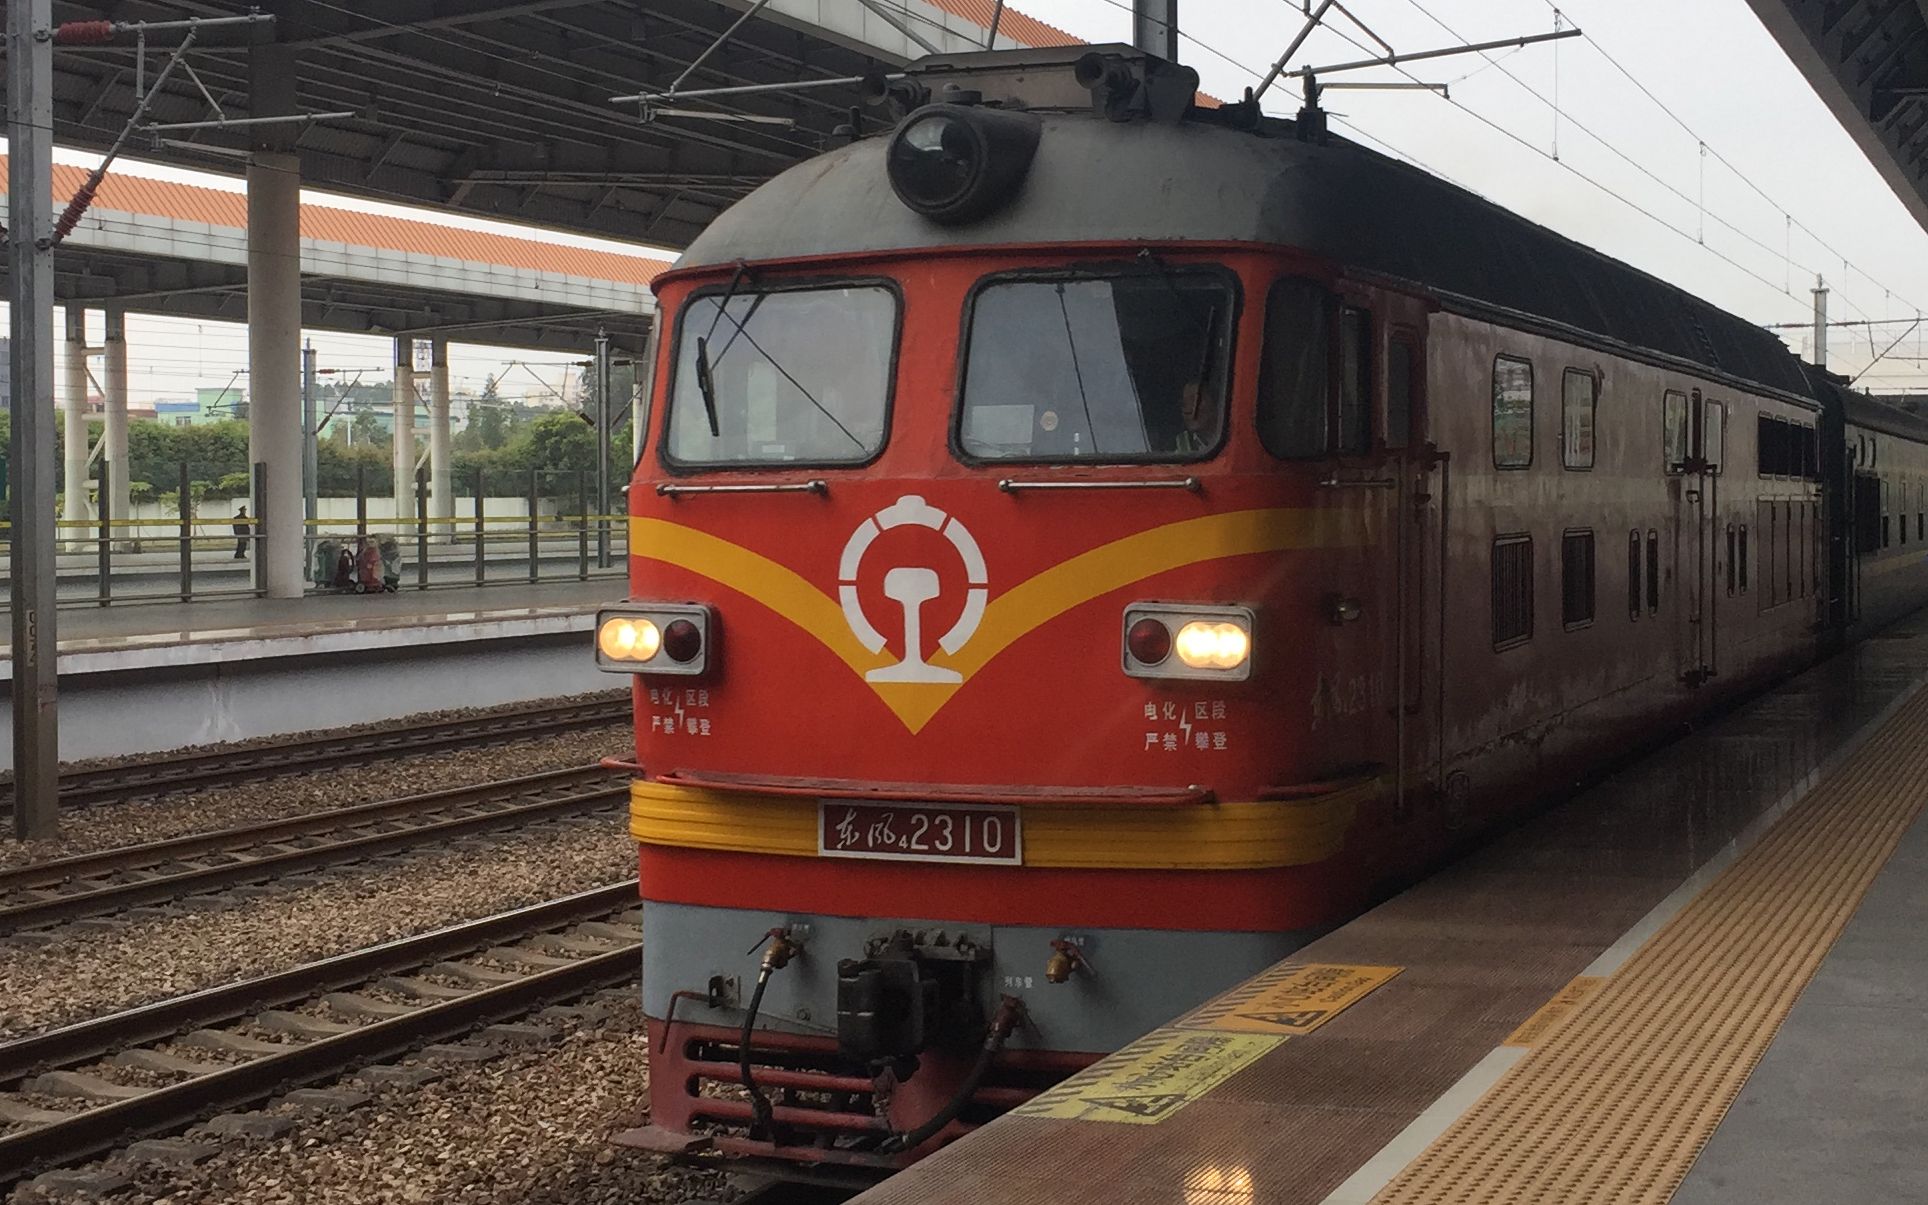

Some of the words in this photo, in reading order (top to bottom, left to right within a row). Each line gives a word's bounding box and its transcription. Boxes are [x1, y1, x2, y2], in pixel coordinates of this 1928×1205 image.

[1144, 701, 1177, 720] 电化
[1194, 700, 1227, 720] 区段
[1144, 732, 1178, 751] 严禁
[1195, 732, 1228, 752] 攀登
